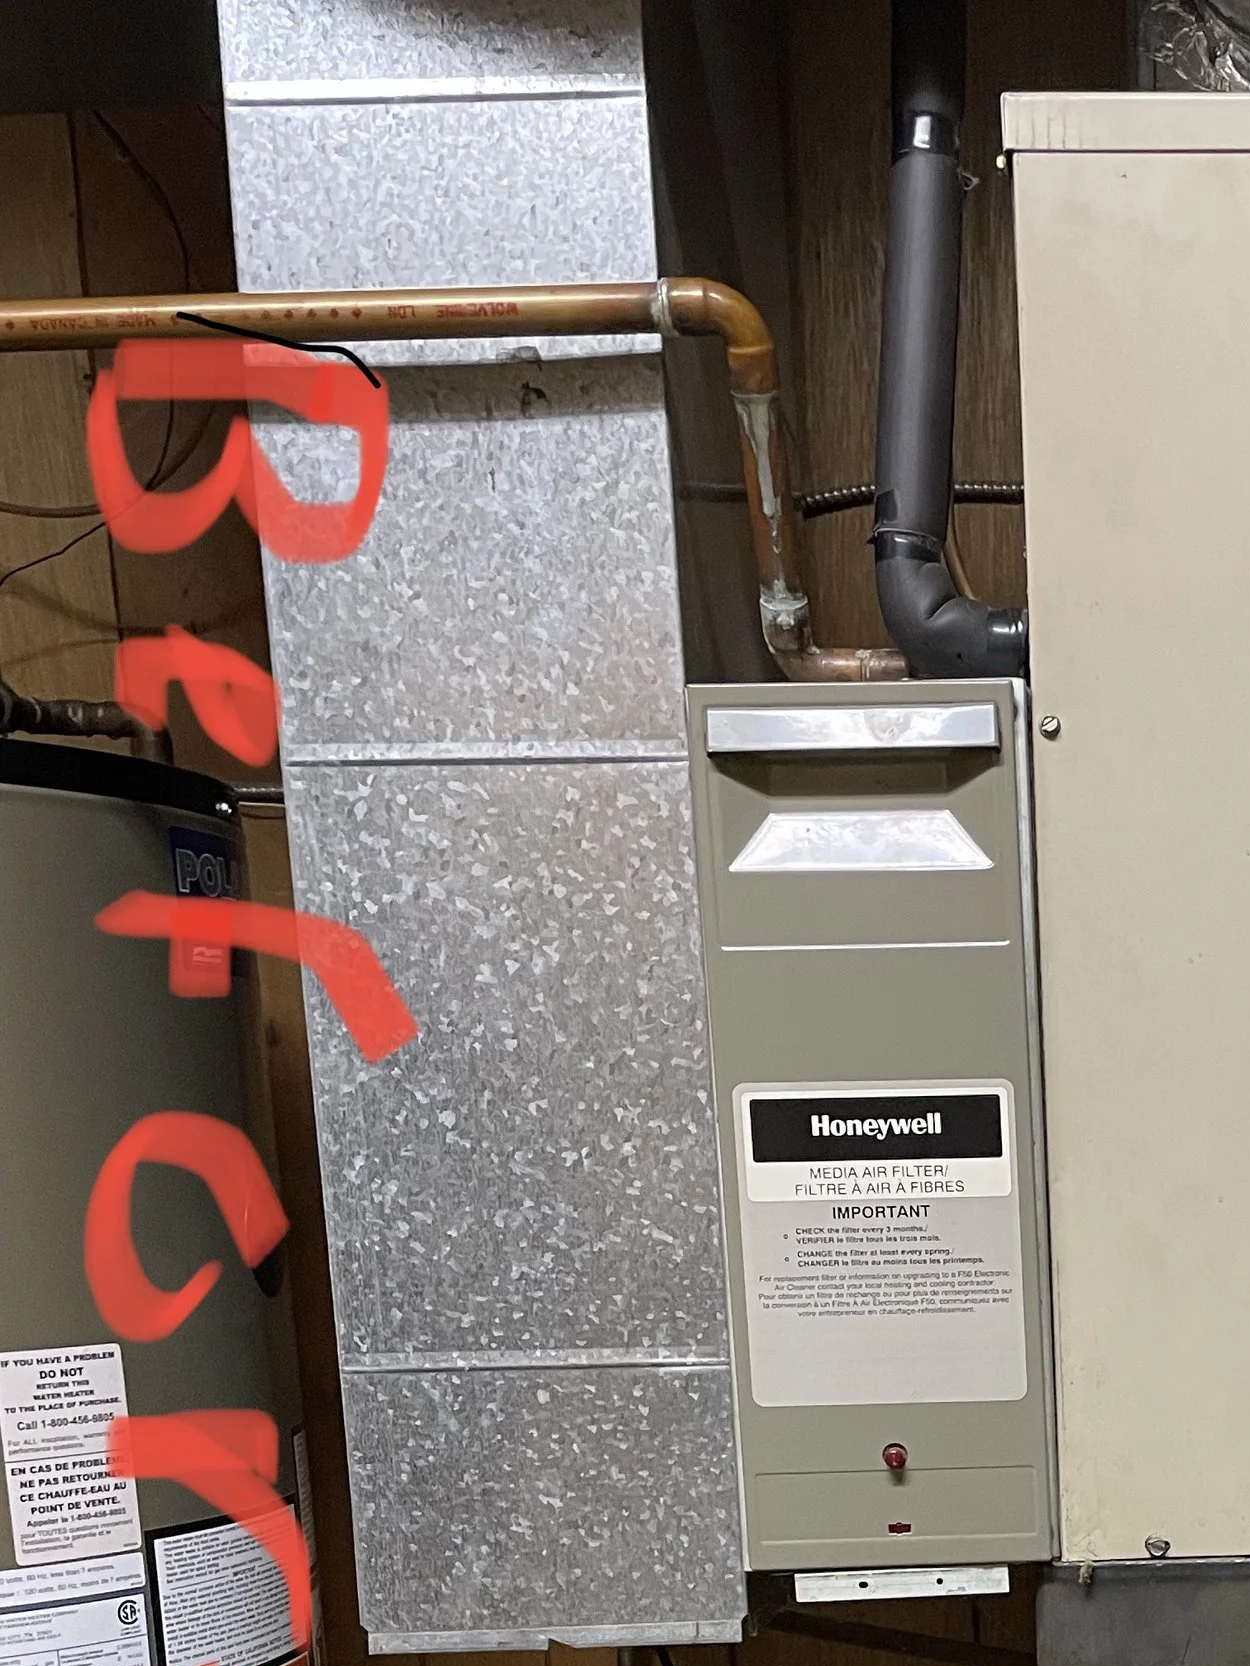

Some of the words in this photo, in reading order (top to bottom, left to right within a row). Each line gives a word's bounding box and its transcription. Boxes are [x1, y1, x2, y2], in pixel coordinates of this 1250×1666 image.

[810, 1111, 942, 1141] Honeywell
[809, 1167, 859, 1180] MEDIA
[861, 1165, 888, 1178] AIR
[892, 1164, 949, 1177] FILTER/
[795, 1182, 848, 1196] FILTRE
[851, 1178, 862, 1195] À
[866, 1181, 892, 1194] AIR
[895, 1178, 907, 1194] À
[910, 1180, 966, 1193] FIBRES
[832, 1204, 931, 1219] IMPORTANT
[795, 1227, 826, 1235] CHECK
[842, 1226, 860, 1234] filter
[862, 1227, 884, 1235] every
[797, 1250, 833, 1258] CHANGE
[850, 1249, 868, 1257] filter
[798, 1259, 840, 1268] CHANGER
[903, 1272, 941, 1281] upgrading
[974, 1270, 1010, 1278] Electronic
[786, 1283, 816, 1291] Cleaner
[846, 1283, 863, 1291] your
[884, 1281, 912, 1289] heating
[929, 1280, 956, 1289] cooling
[846, 1291, 881, 1299] rechange
[894, 1290, 911, 1298] pour
[912, 1289, 929, 1298] plus
[0, 1360, 9, 1368] IF
[12, 1359, 34, 1367] YOU
[36, 1356, 62, 1366] HAVE
[64, 1355, 72, 1363] A
[73, 1351, 115, 1362] PROBLEM
[39, 1370, 57, 1379] DO
[59, 1367, 84, 1377] NOT
[36, 1381, 69, 1390] RETURN
[72, 1379, 90, 1387] THIS
[32, 1392, 62, 1401] WATER
[63, 1389, 95, 1398] HEATER
[18, 1405, 36, 1413] THE
[38, 1403, 64, 1411] PLACE
[66, 1401, 76, 1409] OF
[16, 1420, 38, 1431] Call
[11, 1467, 26, 1476] EN
[29, 1464, 52, 1474] CAS
[55, 1462, 70, 1472] DE
[20, 1480, 35, 1489] NE
[38, 1477, 60, 1487] PAS
[19, 1494, 35, 1503] CE
[38, 1483, 111, 1500] CHAUFFE-EAU
[113, 1481, 127, 1491] AU
[30, 1503, 65, 1515] POINT
[67, 1502, 81, 1511] DE
